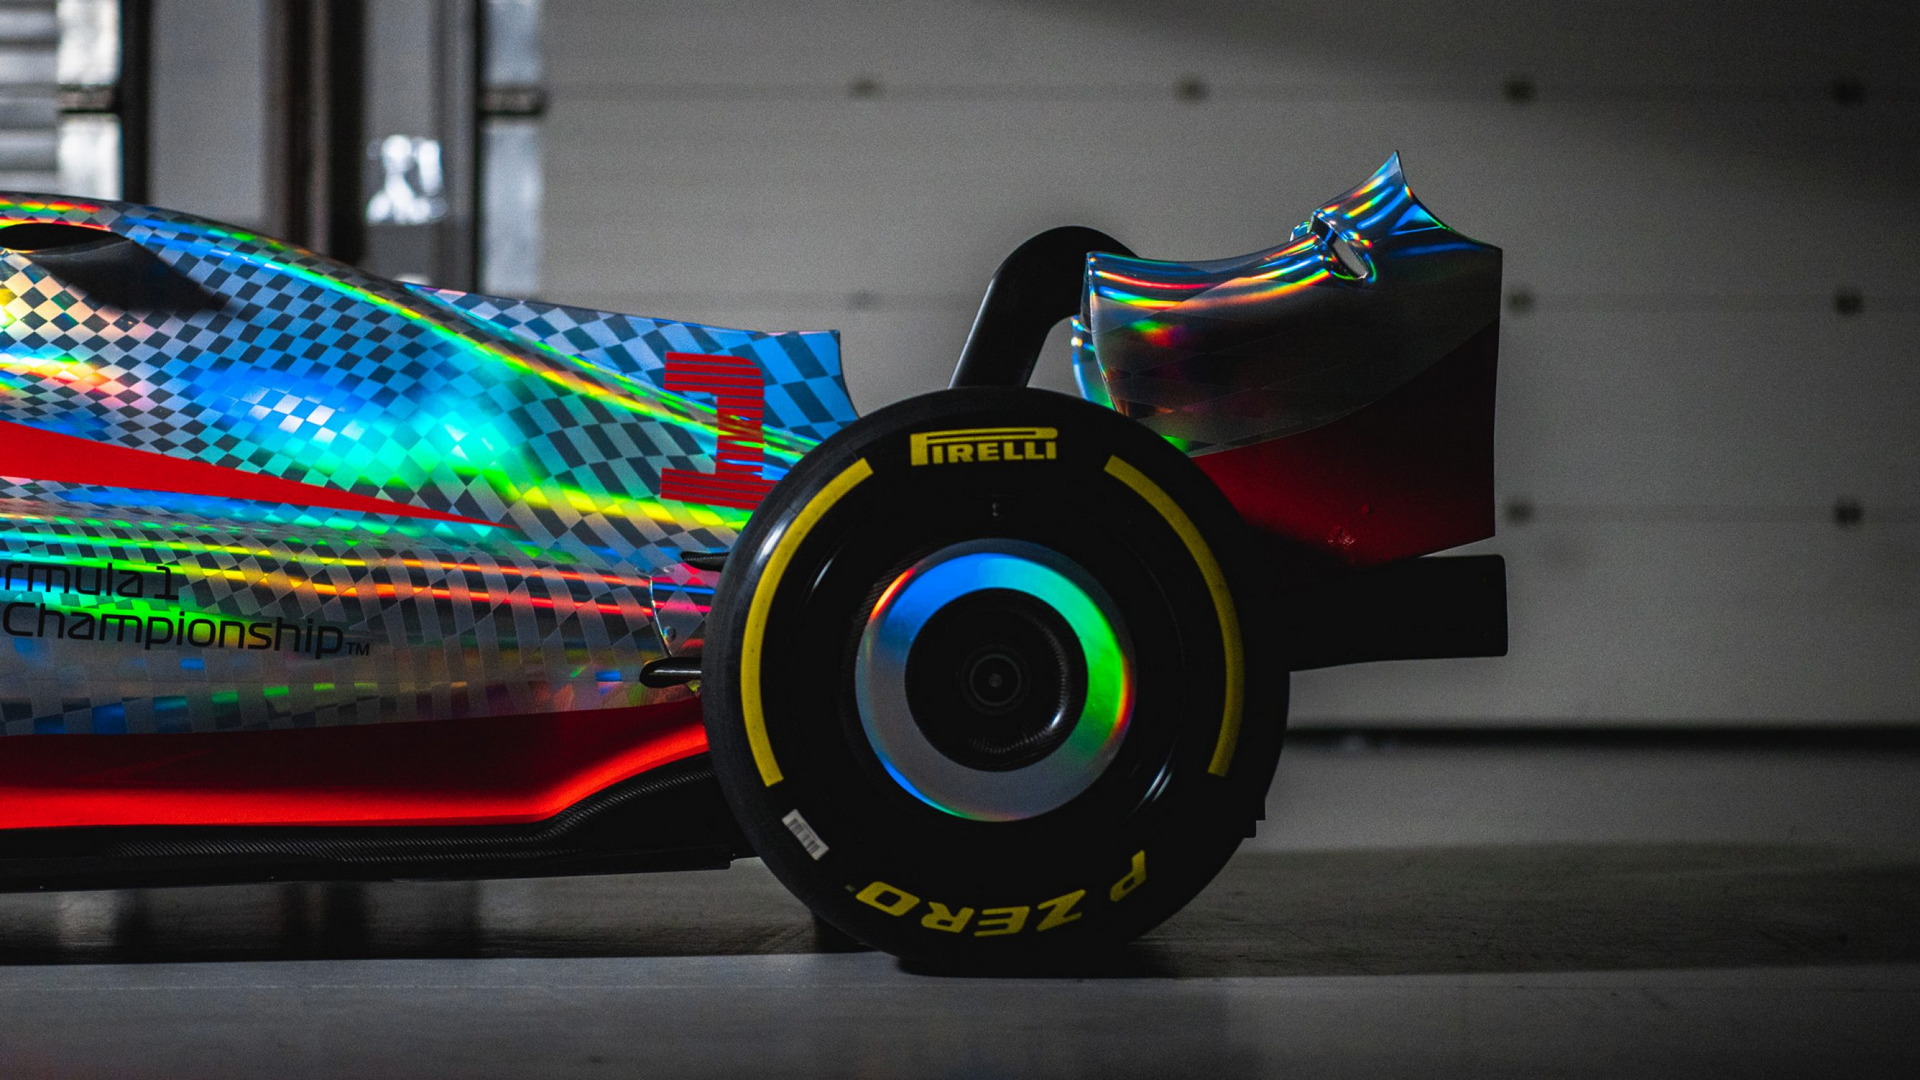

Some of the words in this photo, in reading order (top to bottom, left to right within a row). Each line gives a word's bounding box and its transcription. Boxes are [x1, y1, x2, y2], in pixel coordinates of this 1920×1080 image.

[660, 352, 778, 511] 1
[910, 427, 1059, 467] PIRELLI
[0, 562, 144, 597] rmula
[156, 565, 179, 601] 1
[1109, 849, 1147, 903] P
[855, 880, 1087, 938] ZERO
